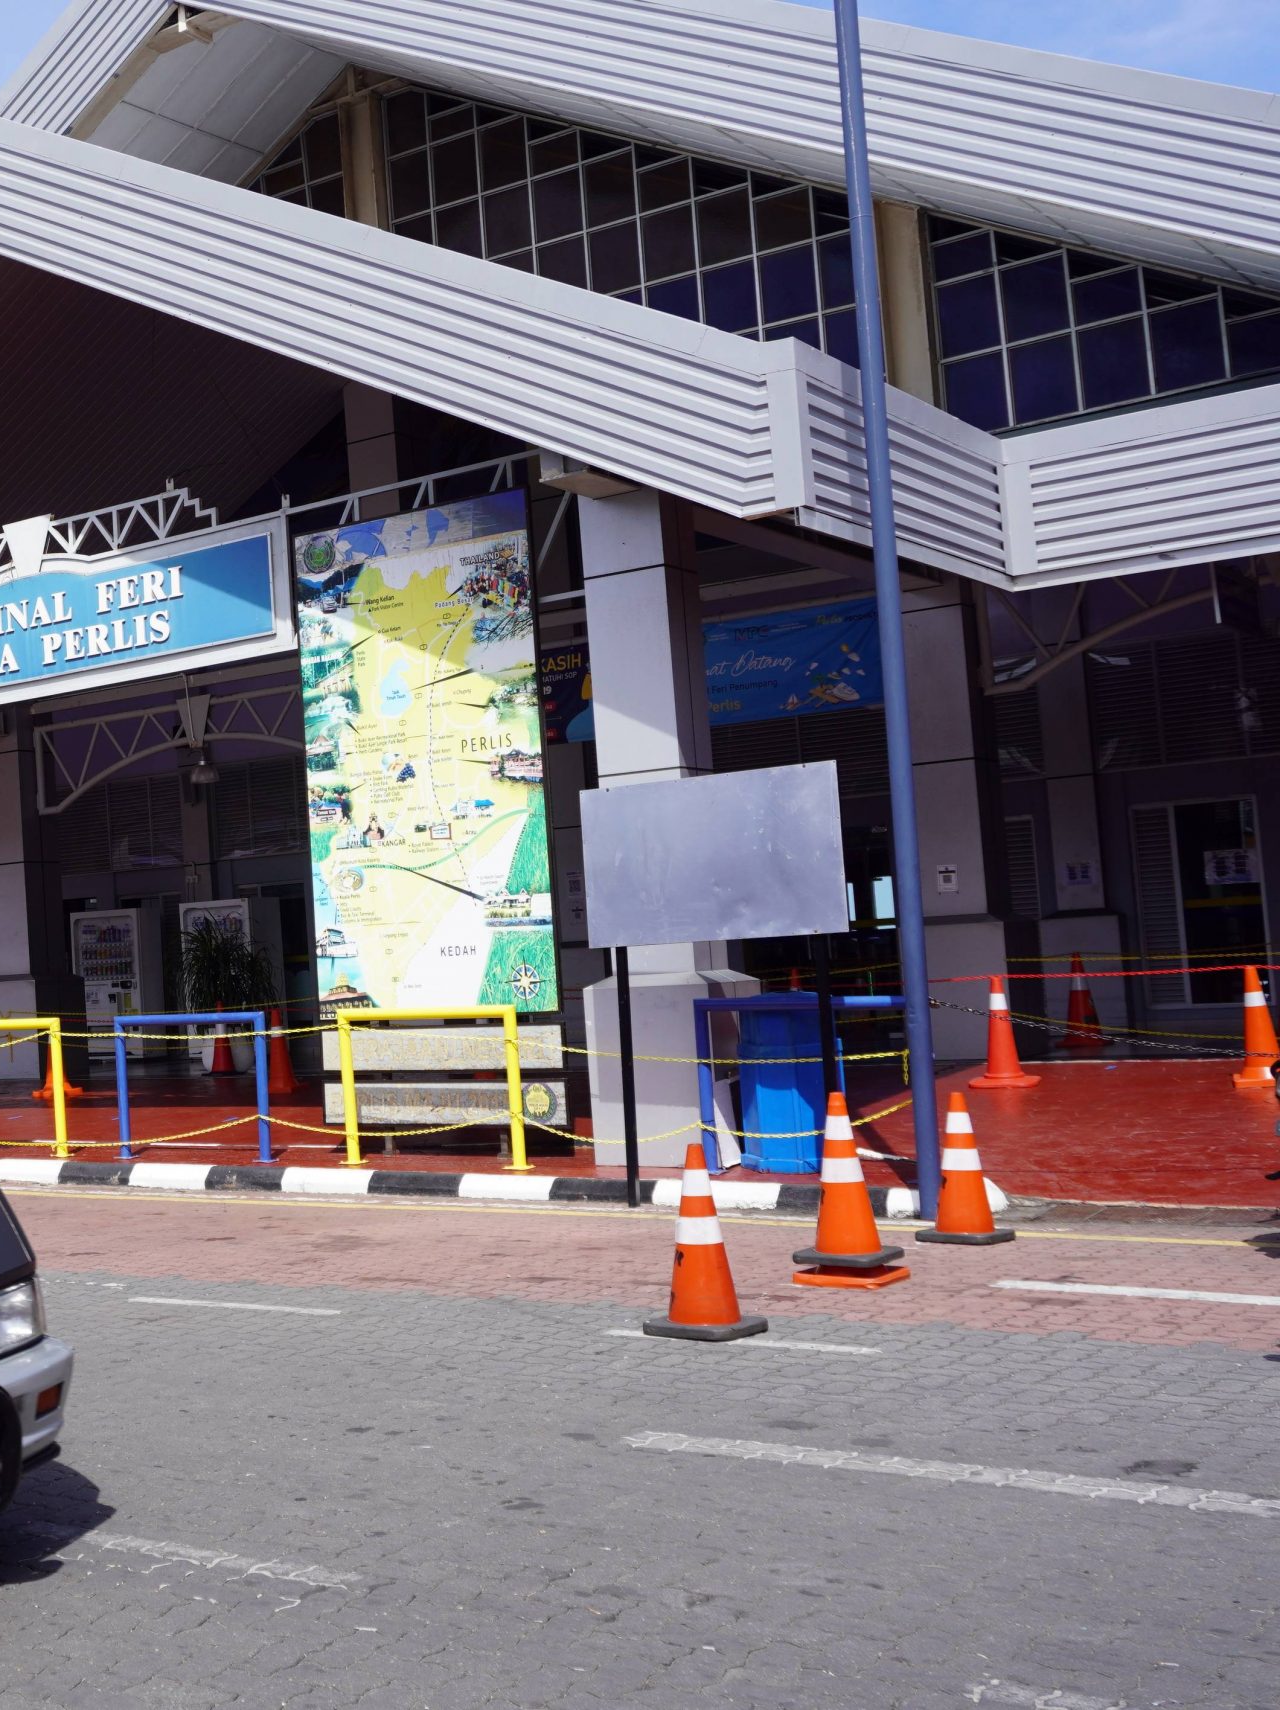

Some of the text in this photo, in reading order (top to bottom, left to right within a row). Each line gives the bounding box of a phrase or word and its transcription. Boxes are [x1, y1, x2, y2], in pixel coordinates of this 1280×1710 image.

[460, 551, 500, 567] THAILAND
[95, 565, 184, 614] FERI
[40, 610, 171, 666] PERLIS
[461, 733, 512, 753] PERLIS
[381, 838, 406, 848] KANGAR
[440, 945, 477, 957] KEDAH
